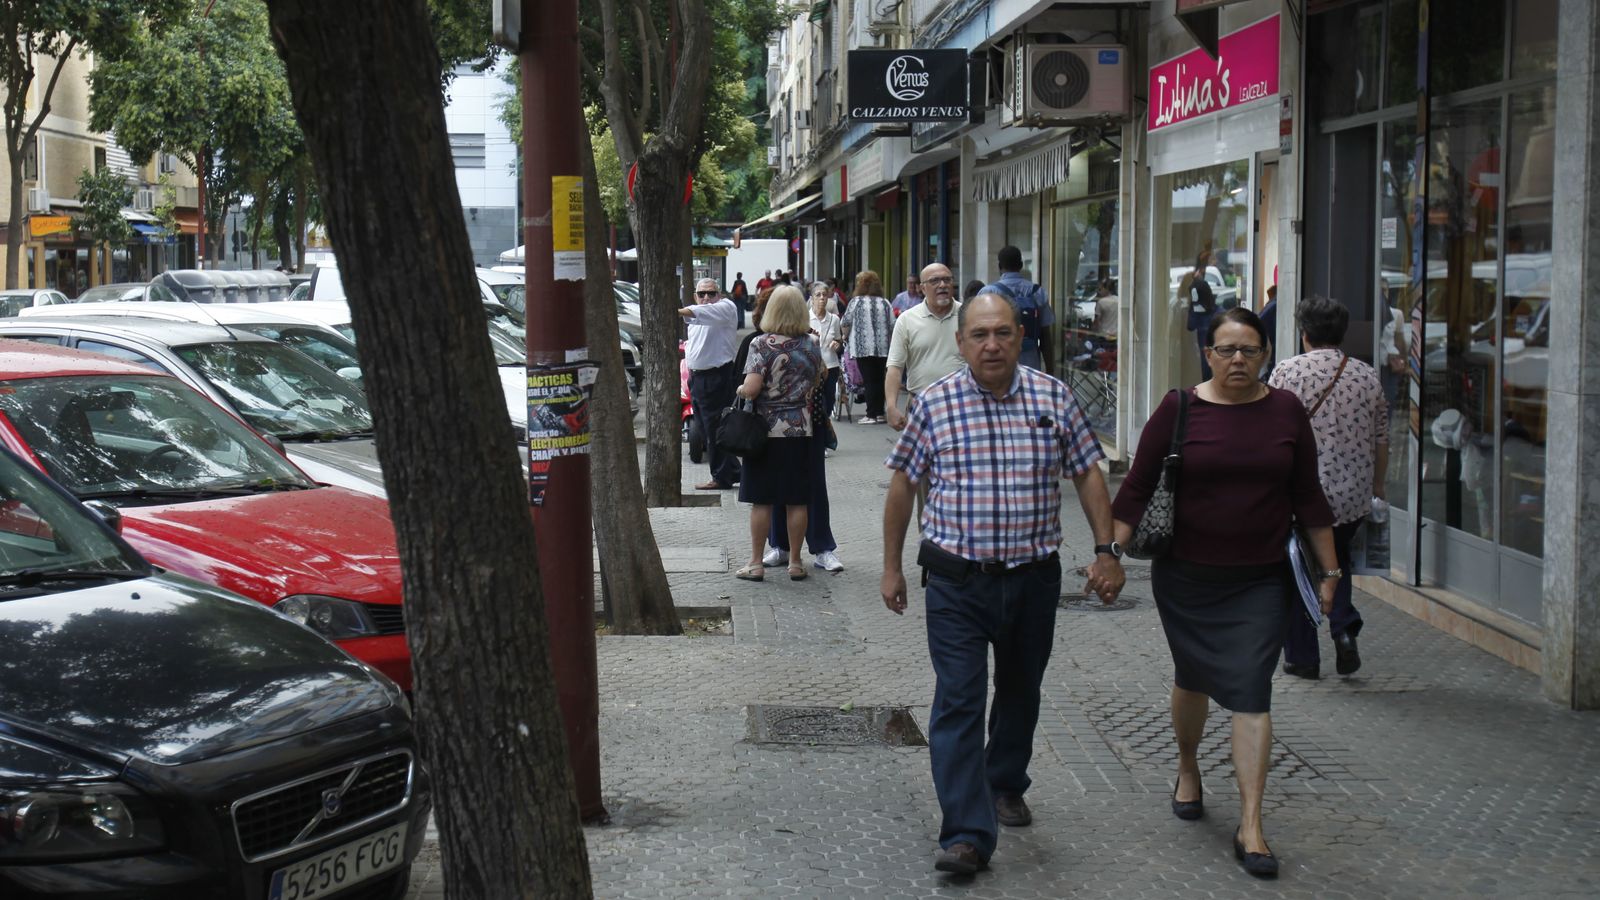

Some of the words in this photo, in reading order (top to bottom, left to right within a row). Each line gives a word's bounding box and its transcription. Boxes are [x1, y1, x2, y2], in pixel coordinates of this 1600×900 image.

[852, 107, 918, 118] CALZADOS
[922, 106, 964, 117] VENUS
[528, 373, 573, 388] RÁCTICAS
[531, 448, 560, 461] CHAPA
[287, 851, 348, 900] 5256
[355, 831, 400, 876] FCG
